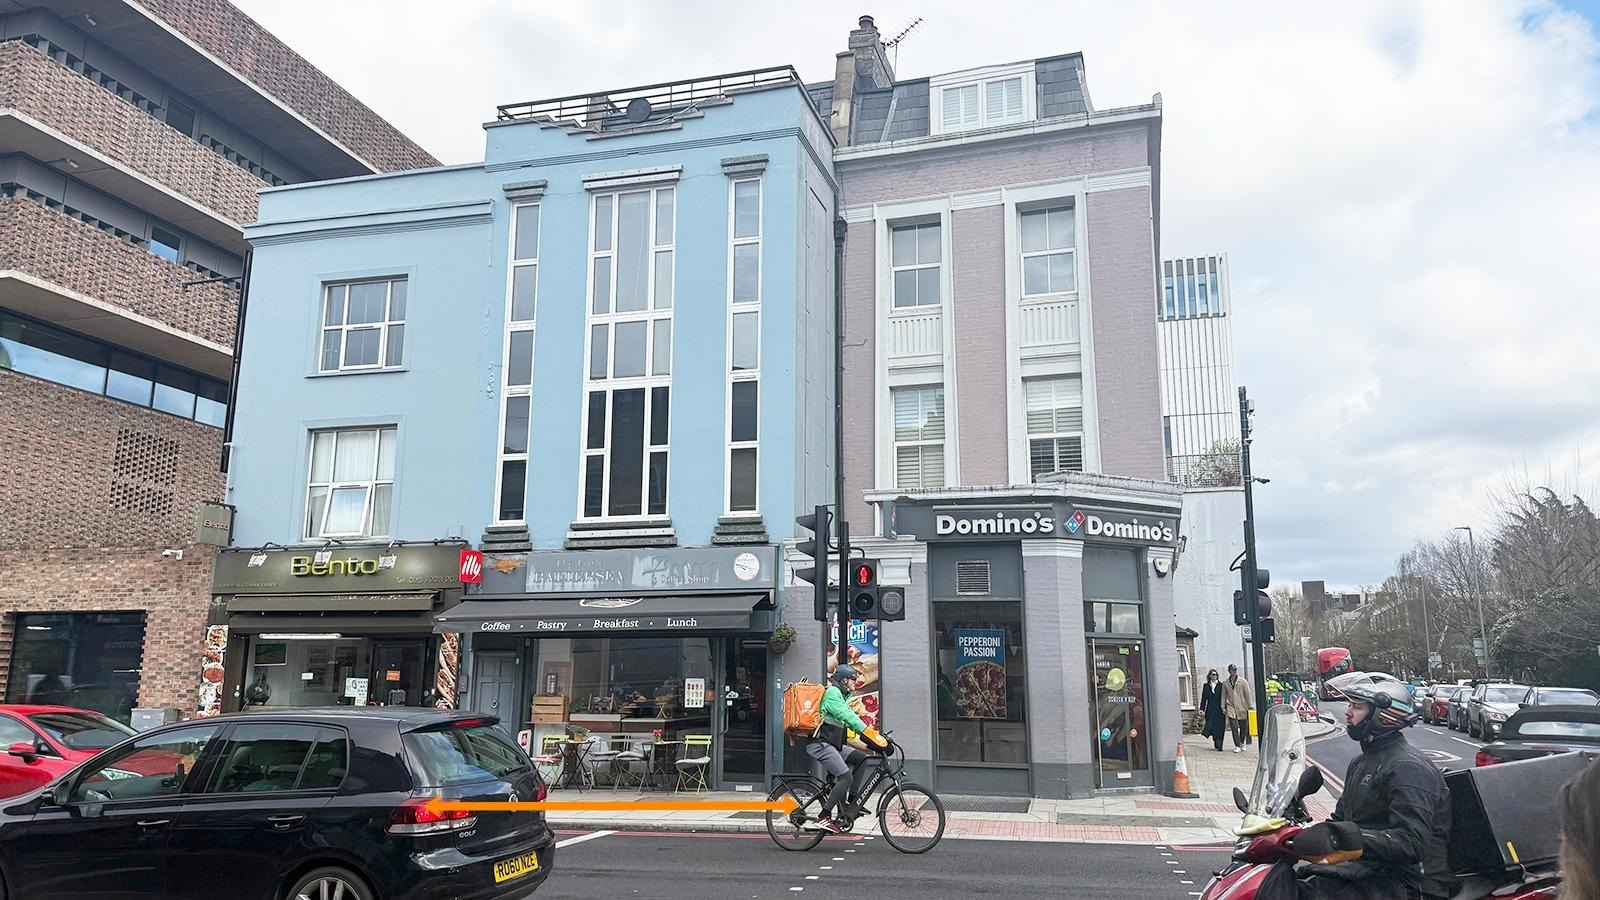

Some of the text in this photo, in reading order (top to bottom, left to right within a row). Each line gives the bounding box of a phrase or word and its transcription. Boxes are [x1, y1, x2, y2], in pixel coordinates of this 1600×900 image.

[936, 512, 1053, 535] Domino's
[1087, 516, 1173, 542] Domino's
[290, 555, 379, 577] Bento
[461, 554, 481, 580] illy
[481, 618, 697, 632] Coffee Pastry Breakfast Lunch
[831, 625, 865, 641] LUCH
[958, 636, 1001, 648] PEPPERONI
[963, 647, 996, 658] PASSION
[861, 773, 880, 799] zoomo
[459, 830, 476, 839] GOLF
[521, 853, 535, 872] NZE
